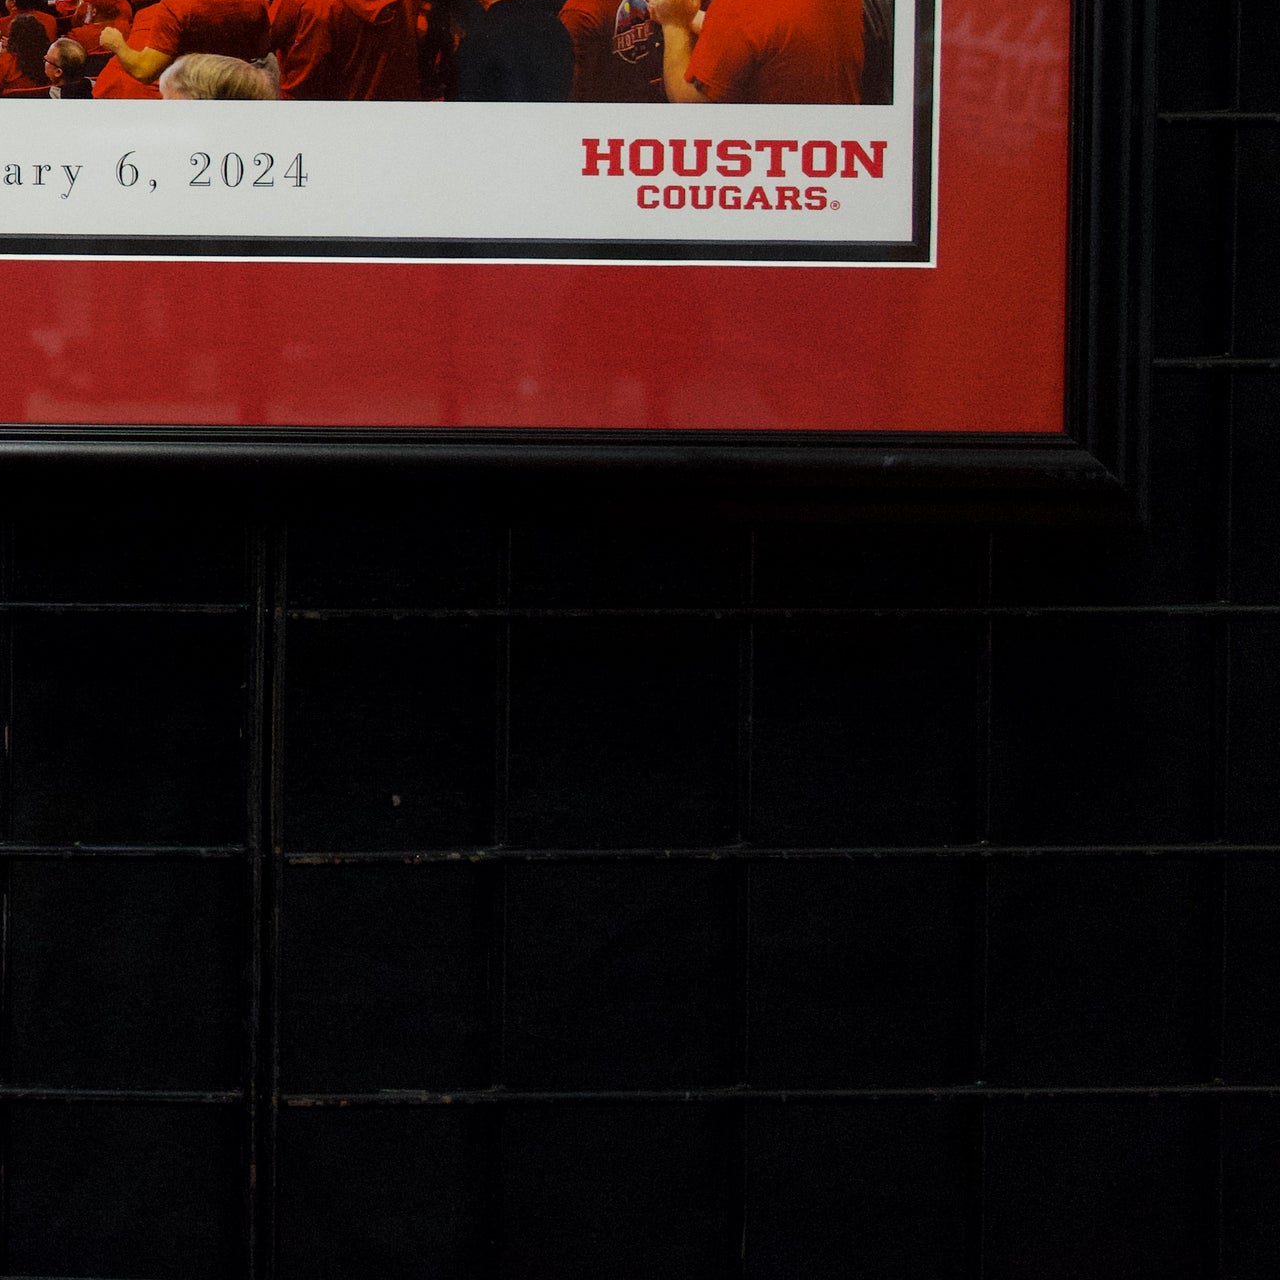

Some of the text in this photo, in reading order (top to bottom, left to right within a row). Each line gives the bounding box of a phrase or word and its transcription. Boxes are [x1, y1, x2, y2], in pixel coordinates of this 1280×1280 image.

[115, 150, 158, 194] 6,
[188, 151, 309, 188] 2024
[582, 138, 888, 178] HOUSTON
[636, 184, 827, 211] COUGARS
